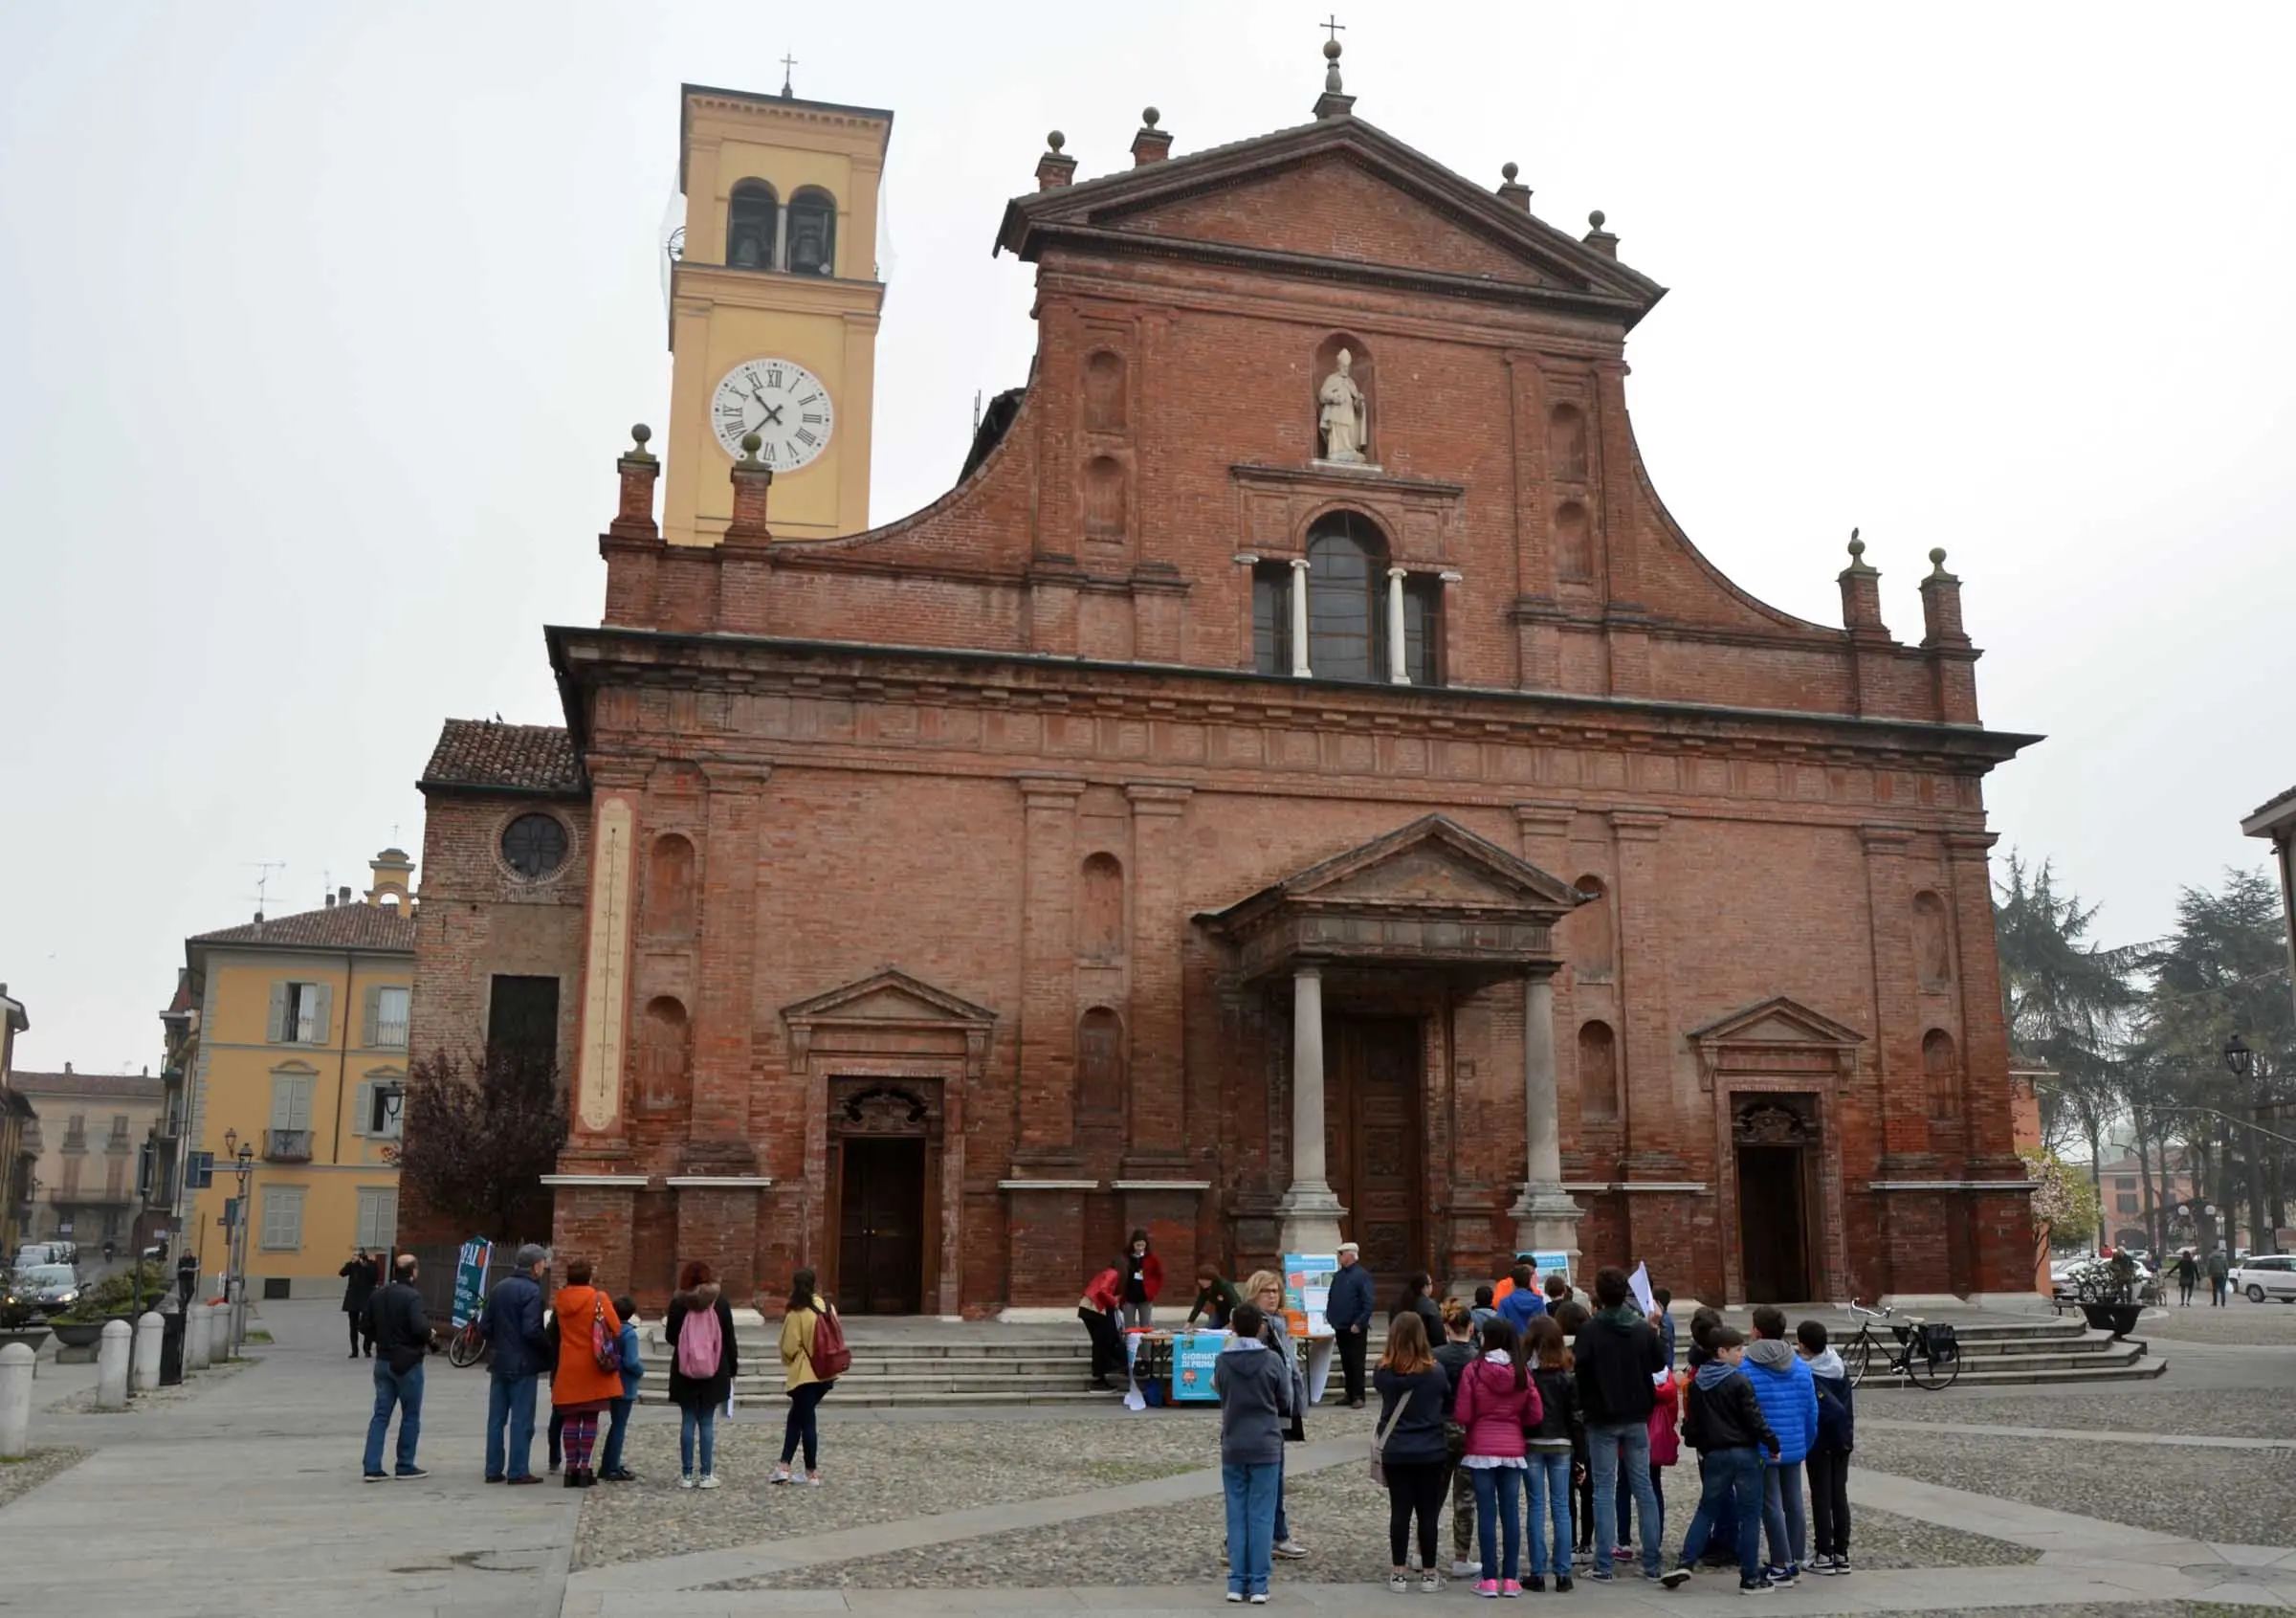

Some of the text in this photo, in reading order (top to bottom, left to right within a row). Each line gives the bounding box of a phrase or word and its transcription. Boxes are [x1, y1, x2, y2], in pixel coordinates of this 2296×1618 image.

[746, 371, 763, 390] XI
[766, 369, 783, 388] XII
[729, 386, 749, 401] X
[798, 394, 818, 406] II
[722, 404, 743, 416] IX
[802, 413, 823, 424] III
[763, 442, 777, 461] VI
[786, 440, 800, 458] V
